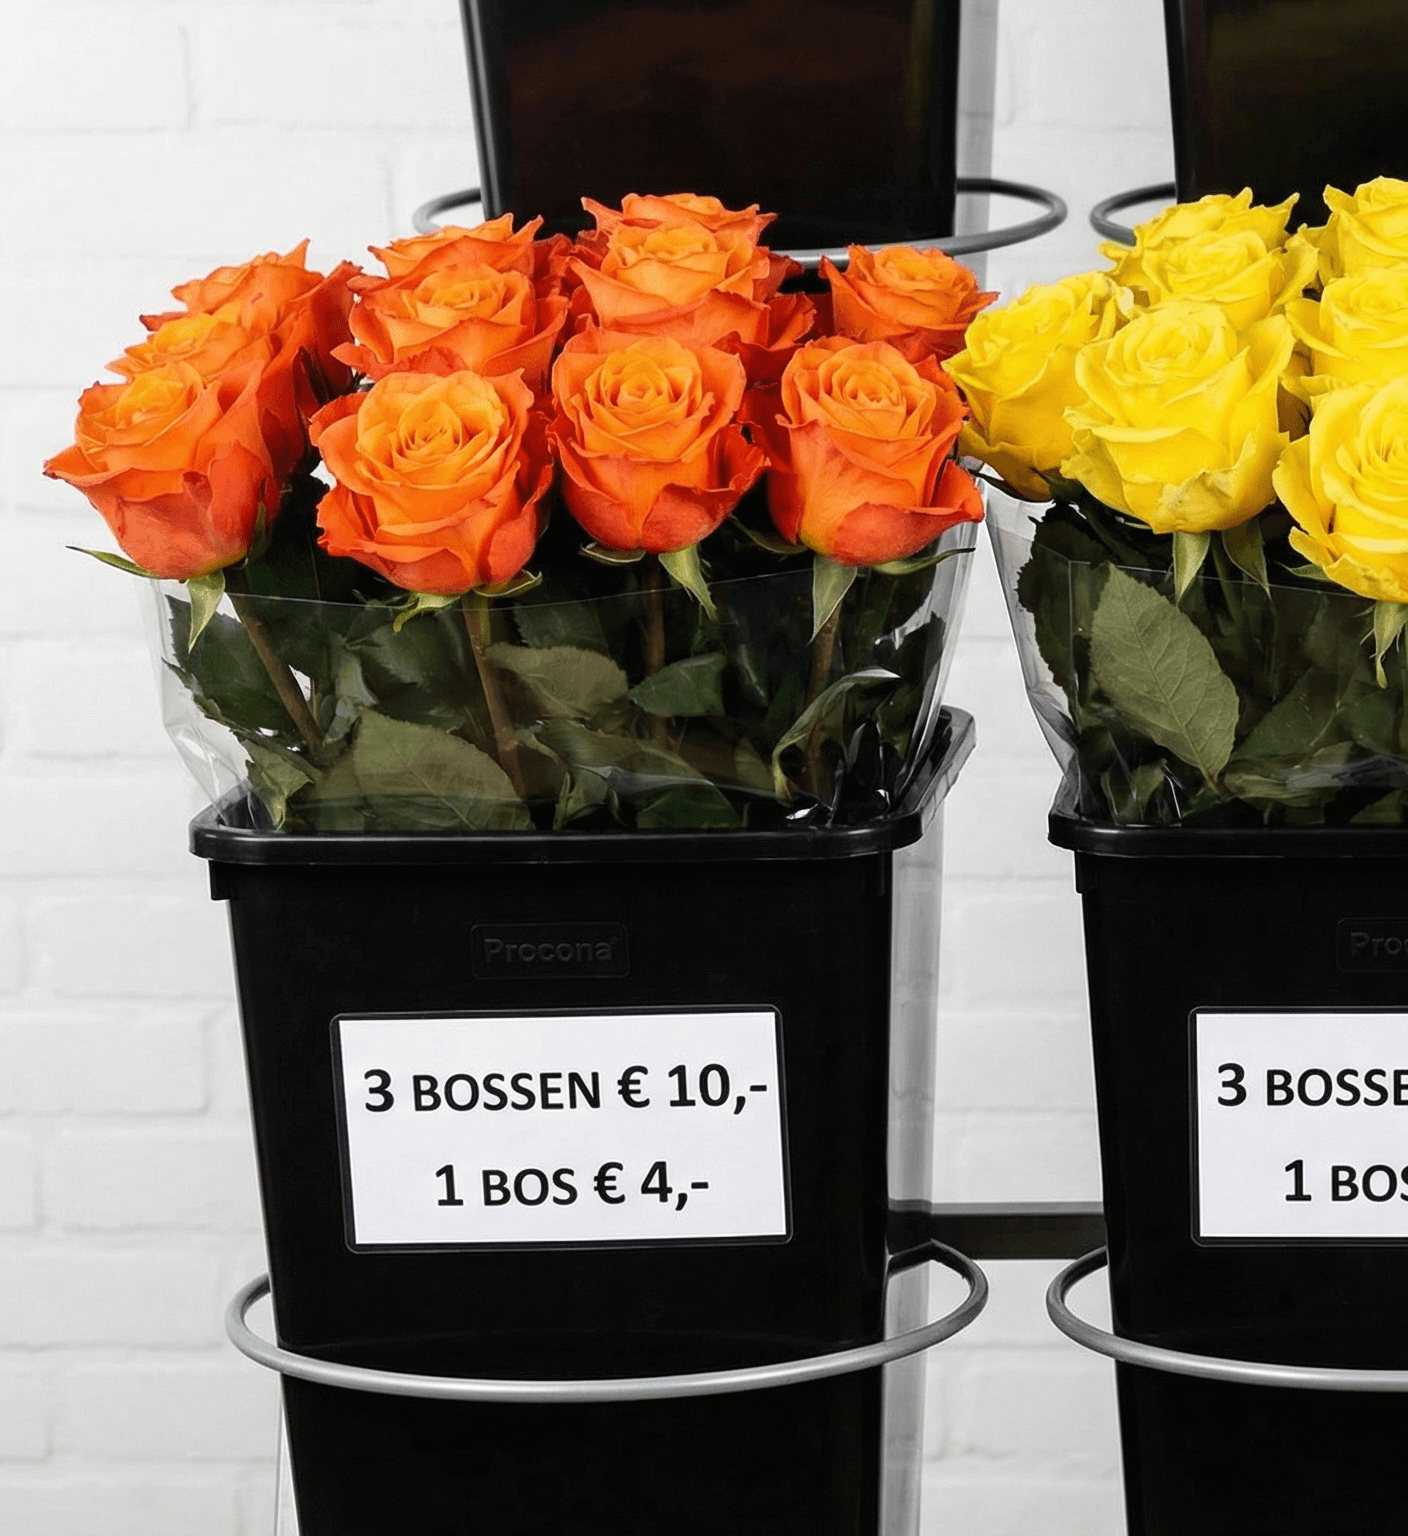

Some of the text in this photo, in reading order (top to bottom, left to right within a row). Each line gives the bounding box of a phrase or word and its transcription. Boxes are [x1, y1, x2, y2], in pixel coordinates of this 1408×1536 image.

[364, 1063, 768, 1115] 3 BOSSEN € 10,-
[1217, 1062, 1247, 1107] 3
[435, 1160, 709, 1212] 1 BOS € 4,-
[1284, 1159, 1312, 1202] 1
